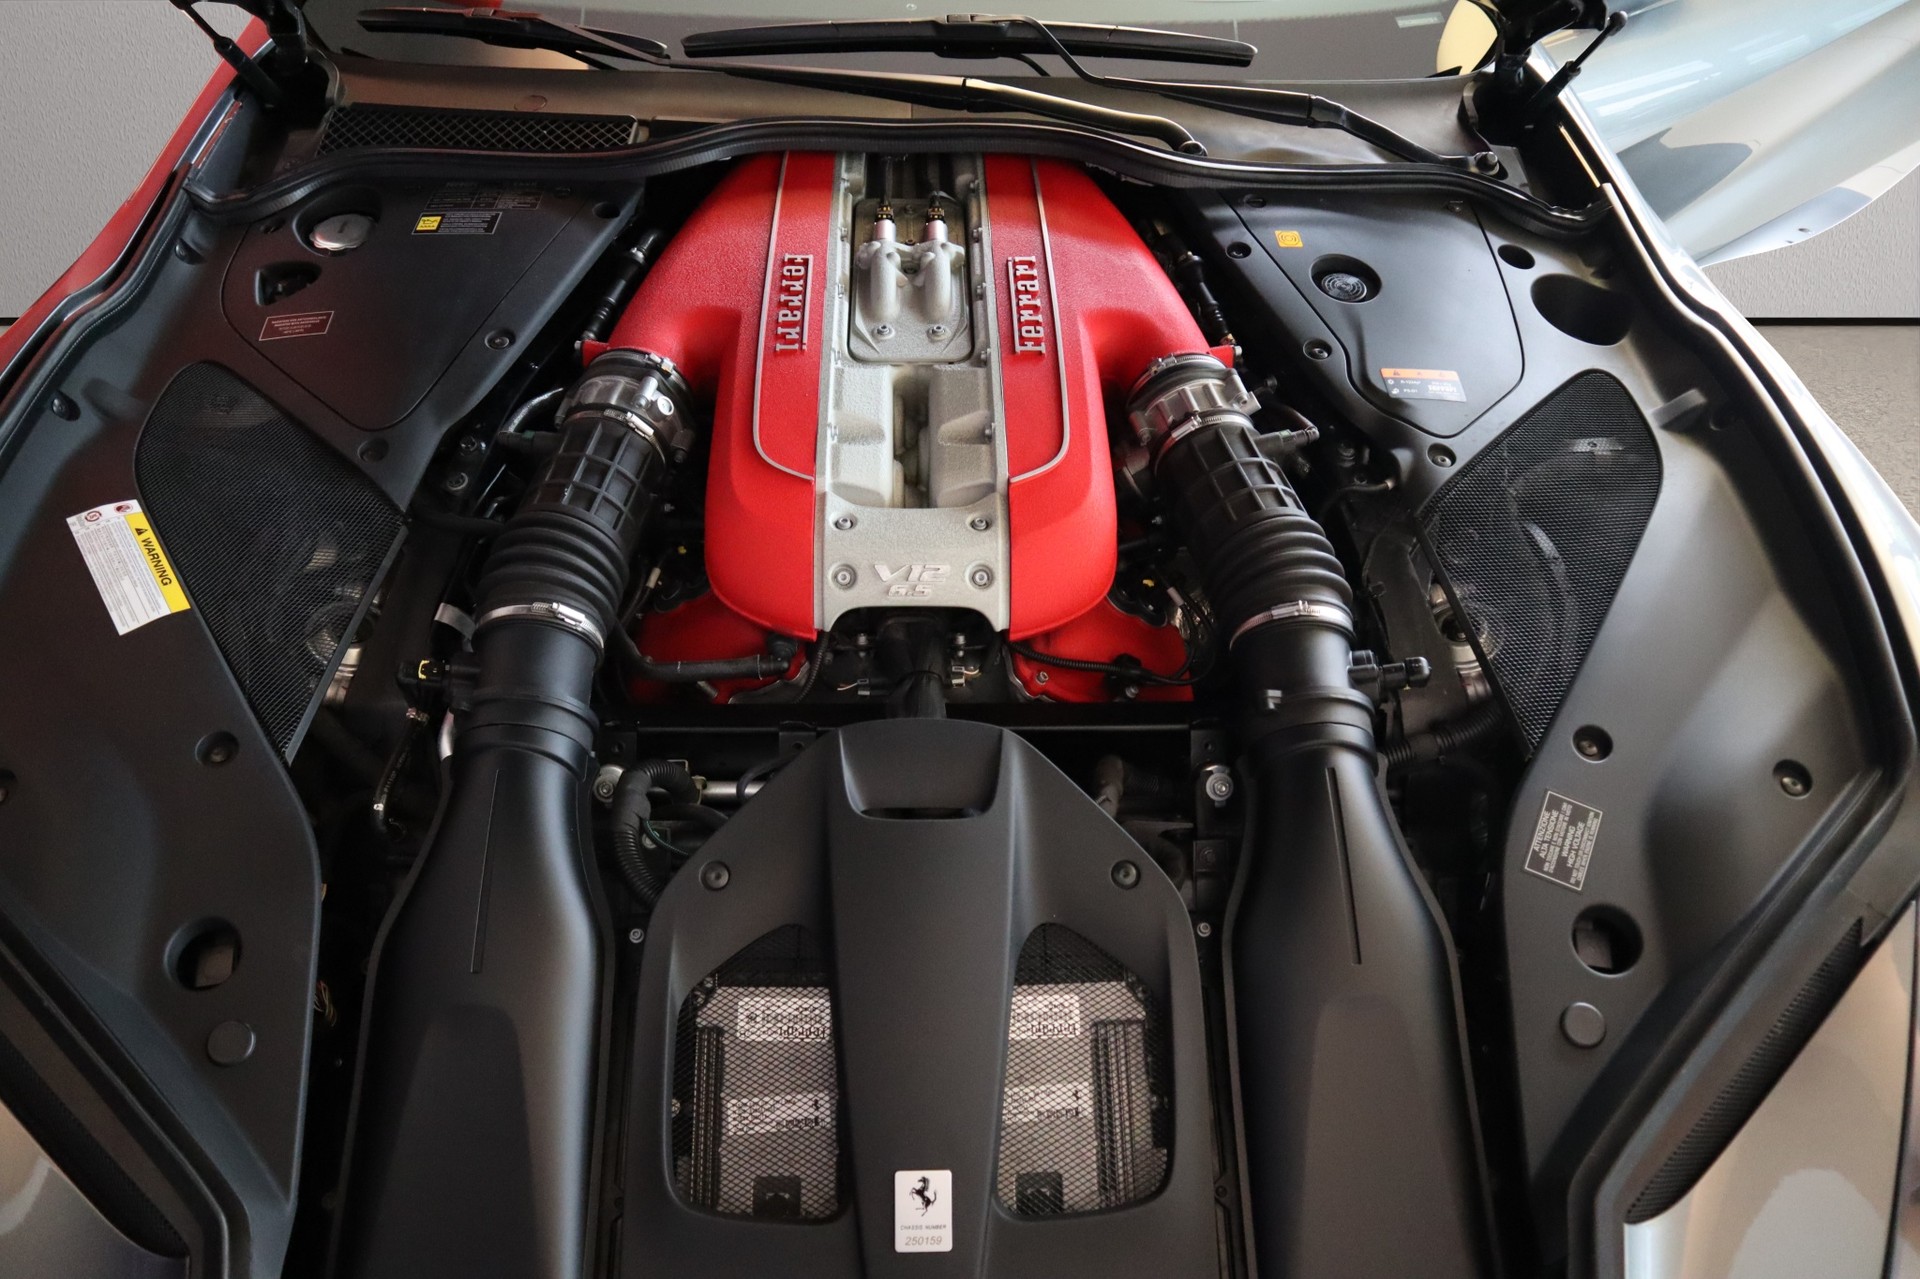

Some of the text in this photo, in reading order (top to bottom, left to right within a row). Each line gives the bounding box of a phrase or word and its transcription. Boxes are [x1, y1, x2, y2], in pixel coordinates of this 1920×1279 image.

[776, 253, 814, 352] Ferrari
[1007, 255, 1046, 354] Ferrari
[141, 537, 173, 587] WARNING
[873, 563, 951, 583] V12
[887, 584, 933, 598] 6.5
[1533, 811, 1551, 852] ATTENZIONE
[1543, 809, 1560, 842] TENSIONE
[1561, 825, 1576, 857] WARNING
[1539, 843, 1549, 859] ALTA
[1566, 850, 1577, 868] HIGH
[1572, 821, 1586, 850] VOLTAGE
[905, 1235, 943, 1247] 250159
